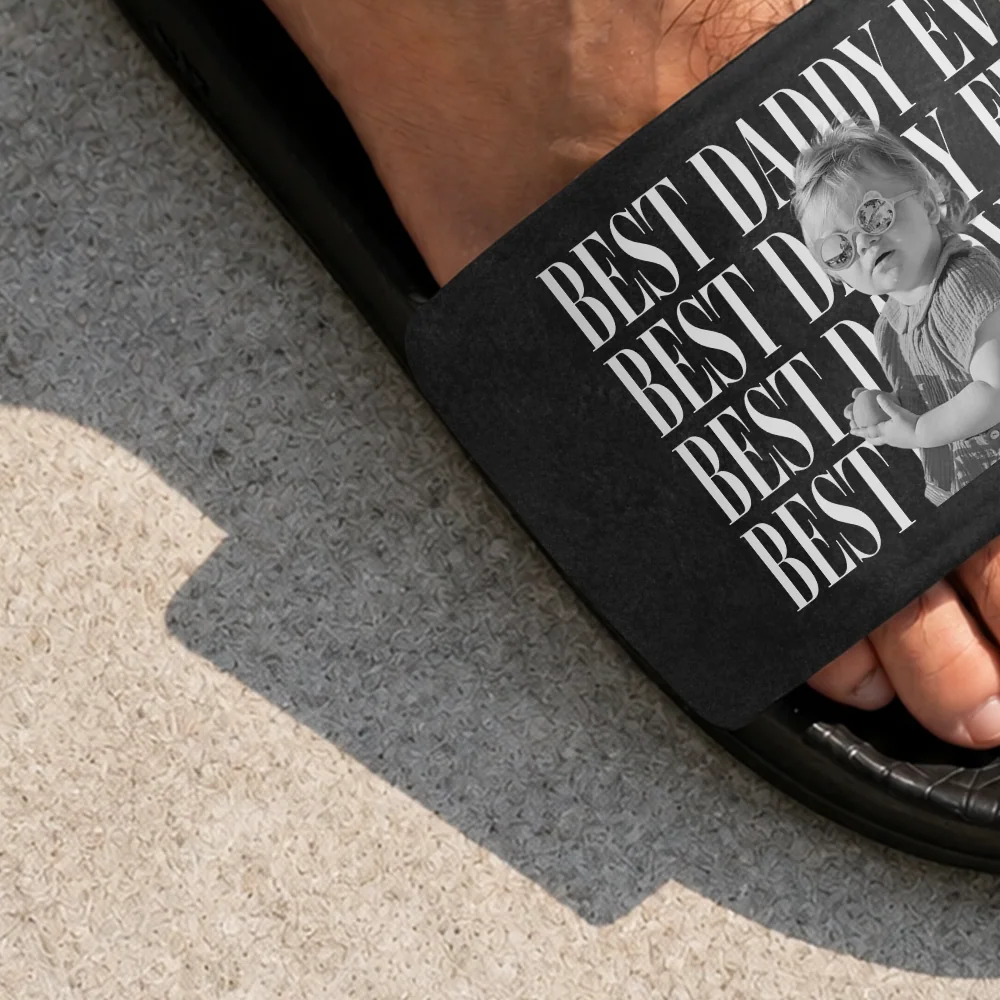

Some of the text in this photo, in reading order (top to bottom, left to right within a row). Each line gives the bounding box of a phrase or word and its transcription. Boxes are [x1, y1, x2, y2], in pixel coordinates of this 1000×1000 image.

[536, 177, 714, 351] BEST
[686, 20, 916, 236] DADDY
[604, 264, 781, 438] BEST
[672, 352, 849, 525] BEST
[740, 437, 916, 611] BEST
